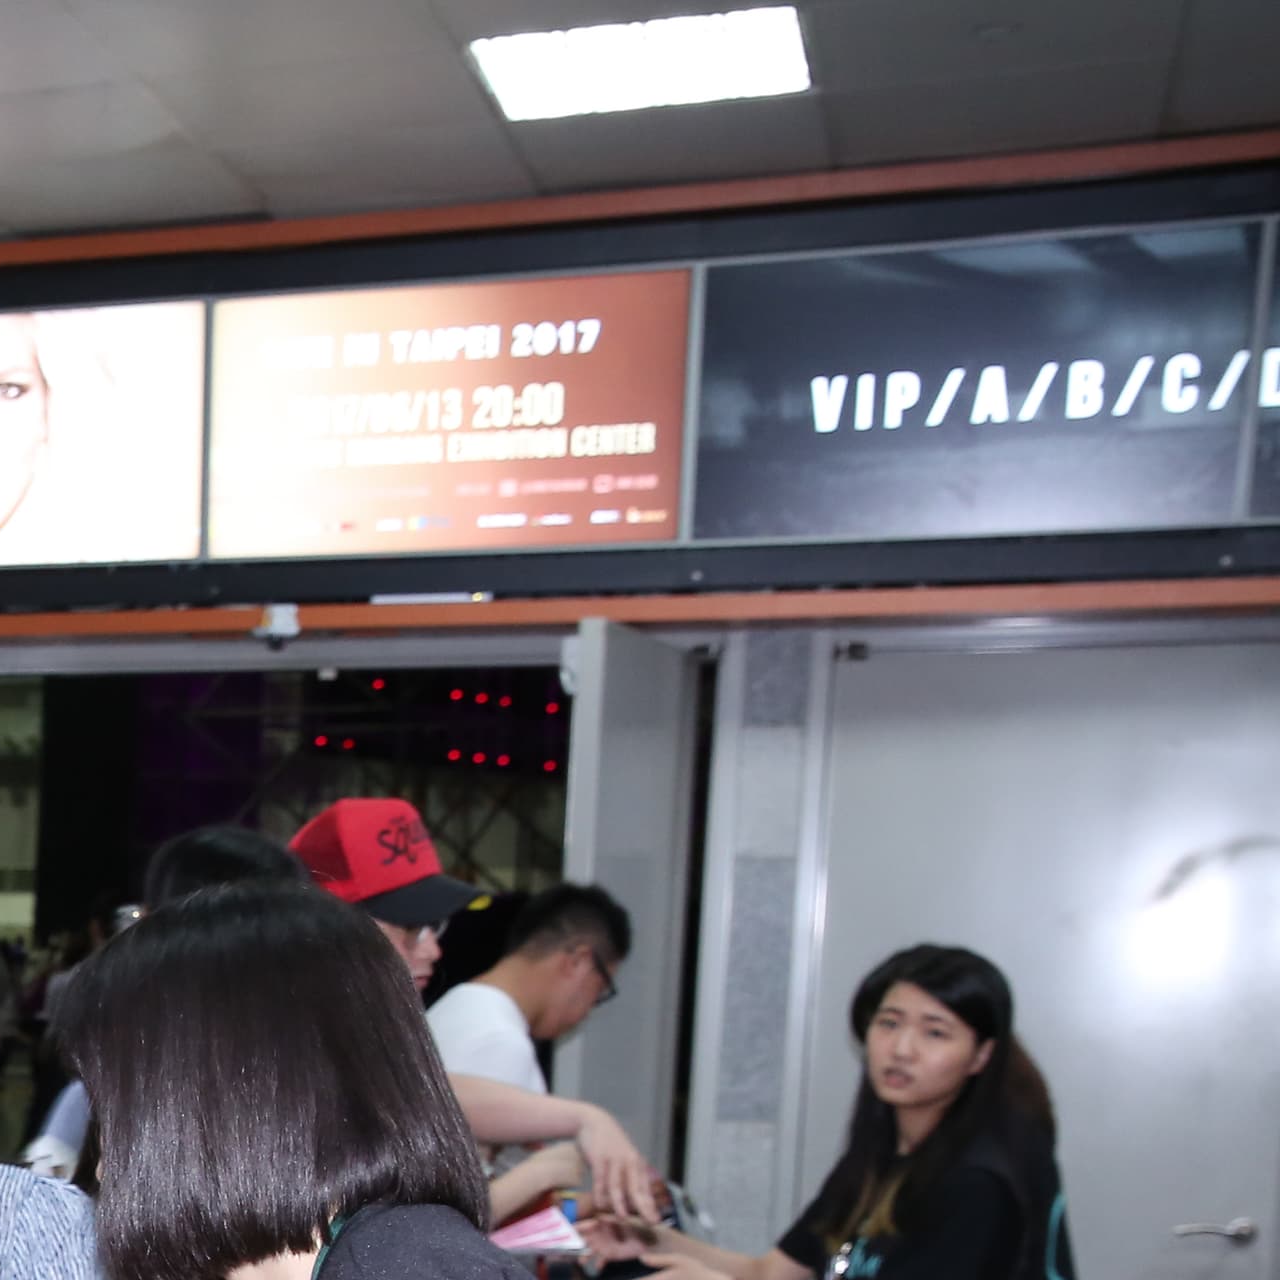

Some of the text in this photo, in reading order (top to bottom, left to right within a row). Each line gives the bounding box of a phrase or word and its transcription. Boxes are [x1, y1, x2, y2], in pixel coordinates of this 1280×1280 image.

[390, 325, 501, 364] TAIPEI
[510, 319, 601, 357] 2017
[571, 421, 657, 458] CENTER
